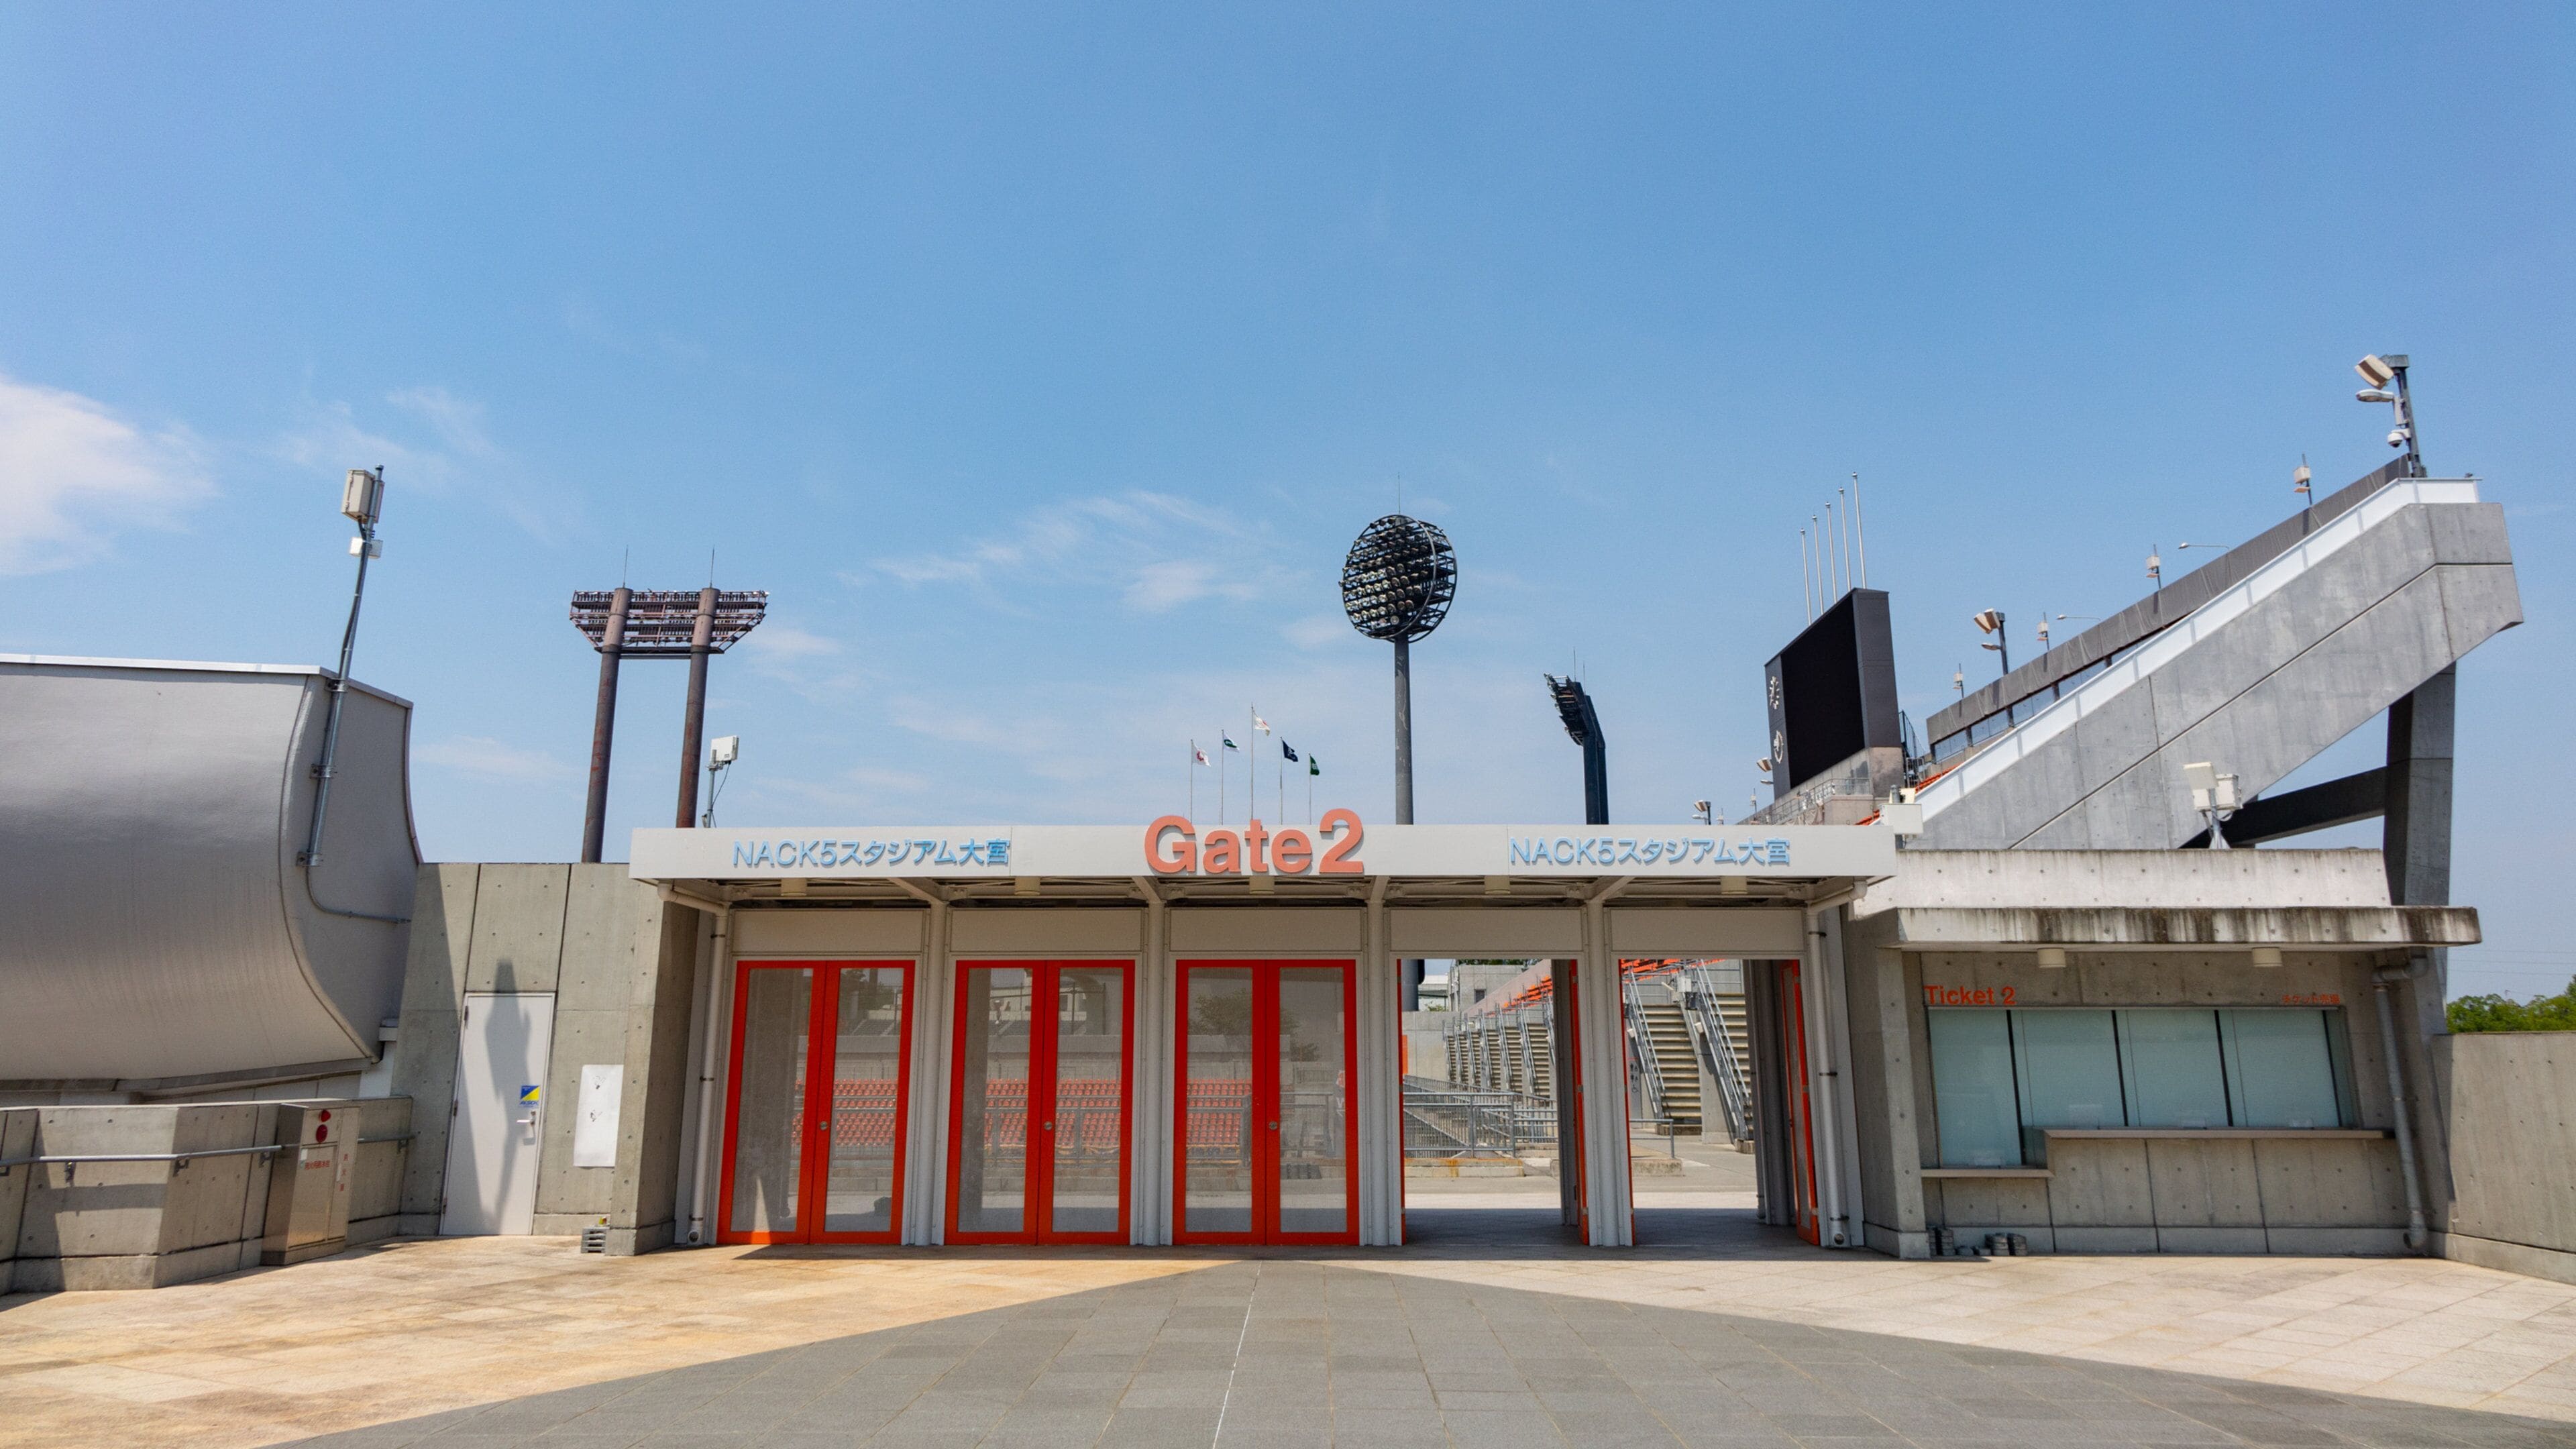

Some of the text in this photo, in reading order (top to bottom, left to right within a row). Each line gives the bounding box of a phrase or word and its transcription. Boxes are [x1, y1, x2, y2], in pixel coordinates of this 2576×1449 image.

[733, 838, 1010, 867] NACK5スタジアム大宮
[1509, 837, 1790, 866] NACK5スタジアム大宮
[1924, 985, 2017, 1005] Ticket 2
